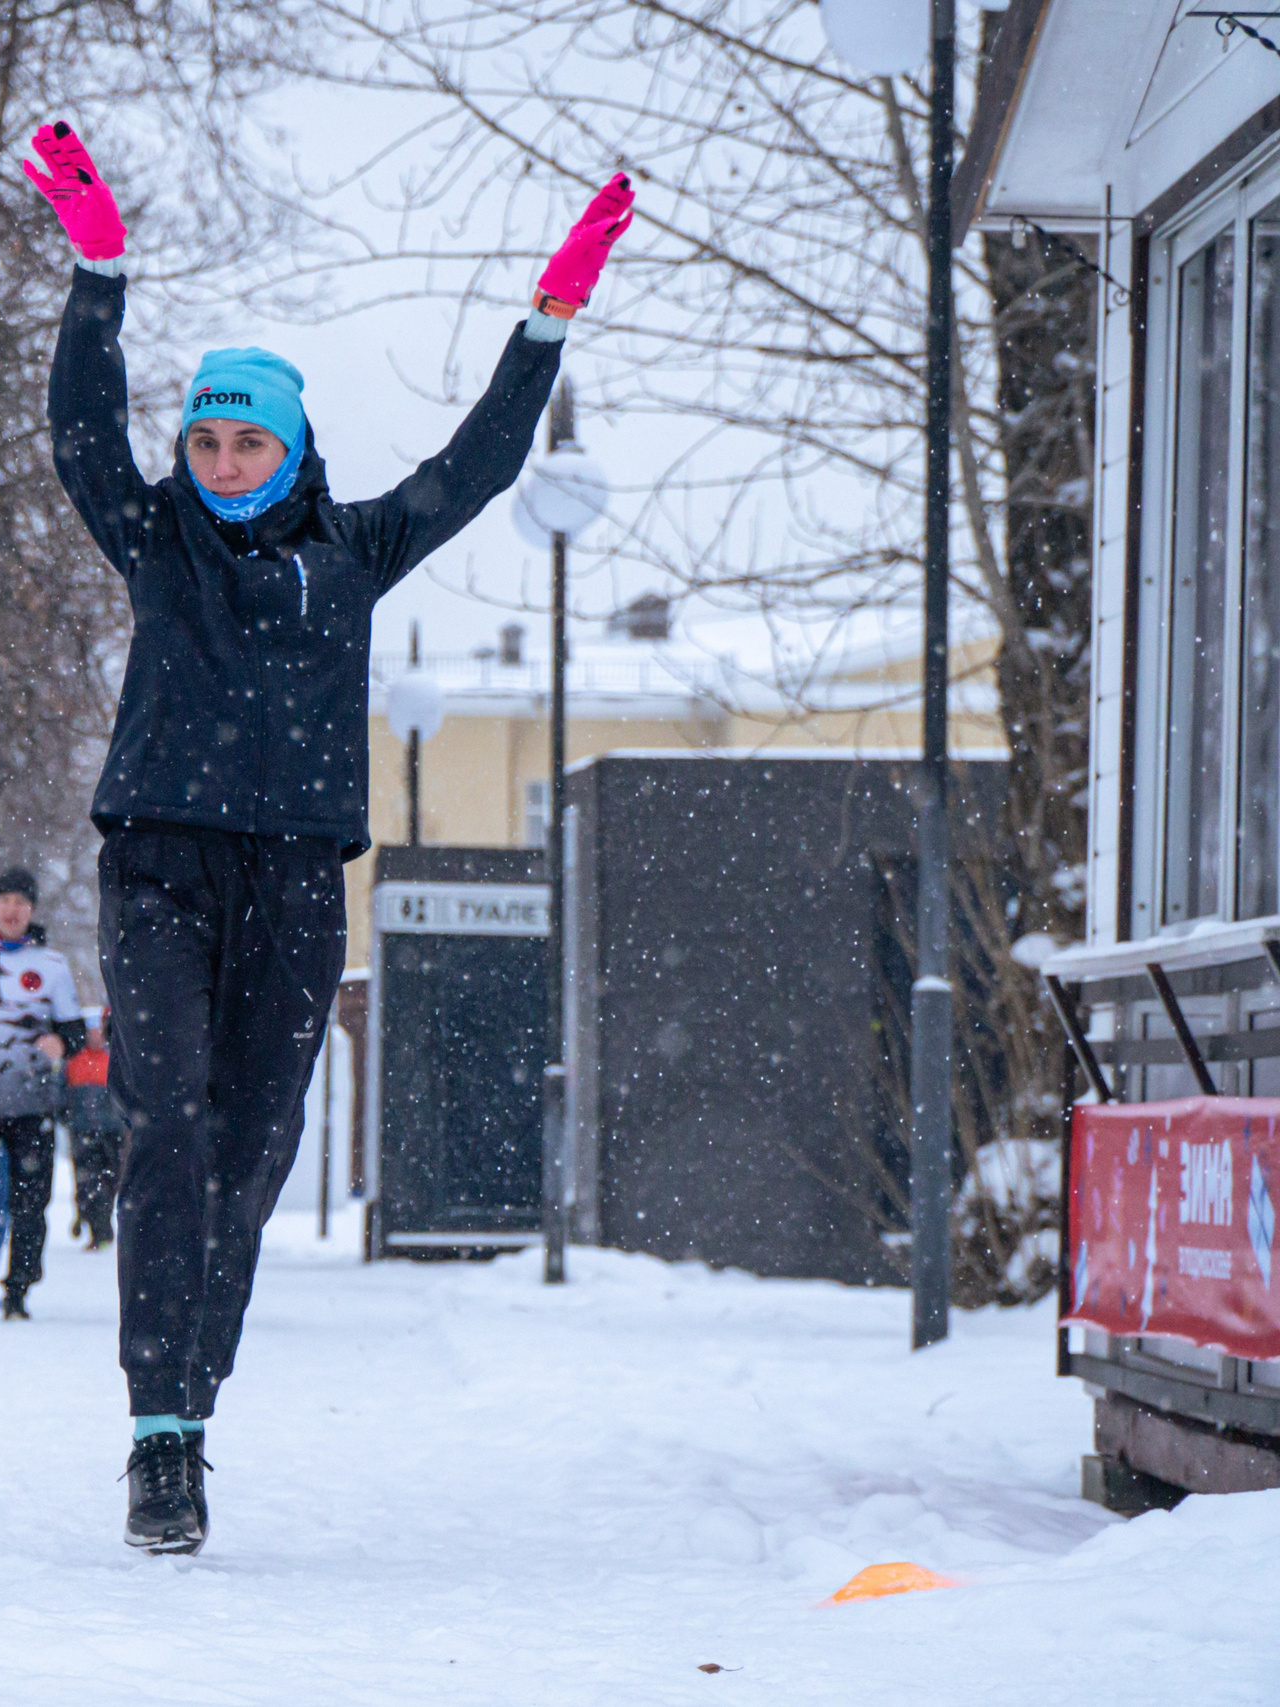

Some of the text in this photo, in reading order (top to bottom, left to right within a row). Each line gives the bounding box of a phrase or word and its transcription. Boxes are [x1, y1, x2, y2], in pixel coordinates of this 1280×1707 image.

[191, 386, 253, 413] grom
[458, 900, 548, 924] ТУАЛЕ
[1179, 1139, 1233, 1227] ЗИМА
